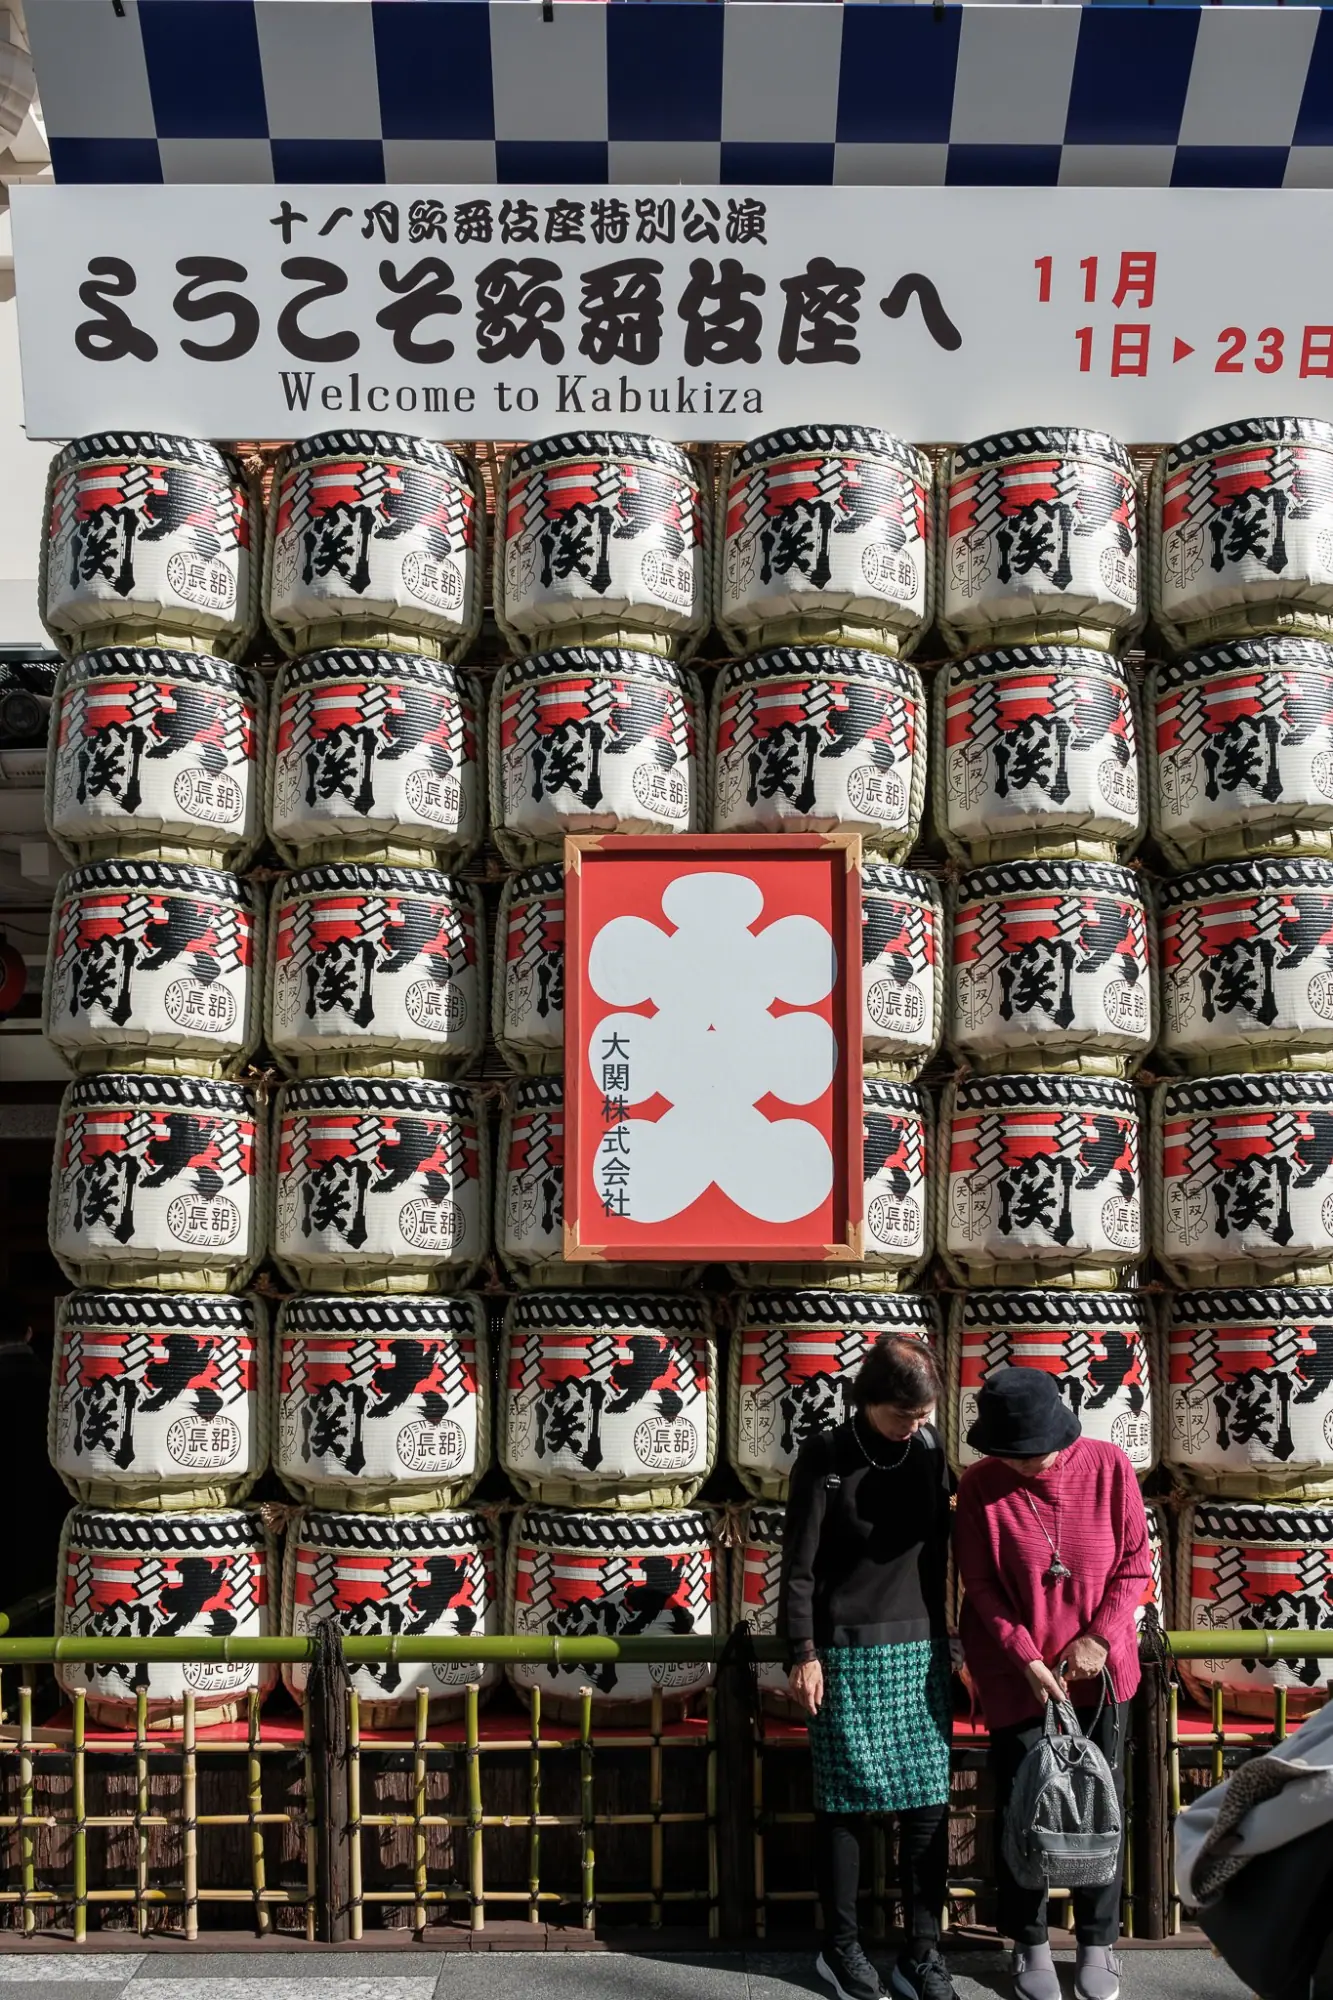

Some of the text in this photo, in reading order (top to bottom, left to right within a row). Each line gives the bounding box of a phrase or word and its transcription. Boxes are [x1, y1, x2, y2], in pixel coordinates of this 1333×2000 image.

[270, 199, 768, 246] 十一月歌舞伎座特別公演
[1034, 251, 1158, 309] 11月
[75, 256, 962, 367] ようこそ歌舞伎座へ
[1075, 324, 1151, 377] 1日
[279, 372, 764, 414] Welcome to Kabukiza
[601, 1032, 631, 1217] 大関株式会社
